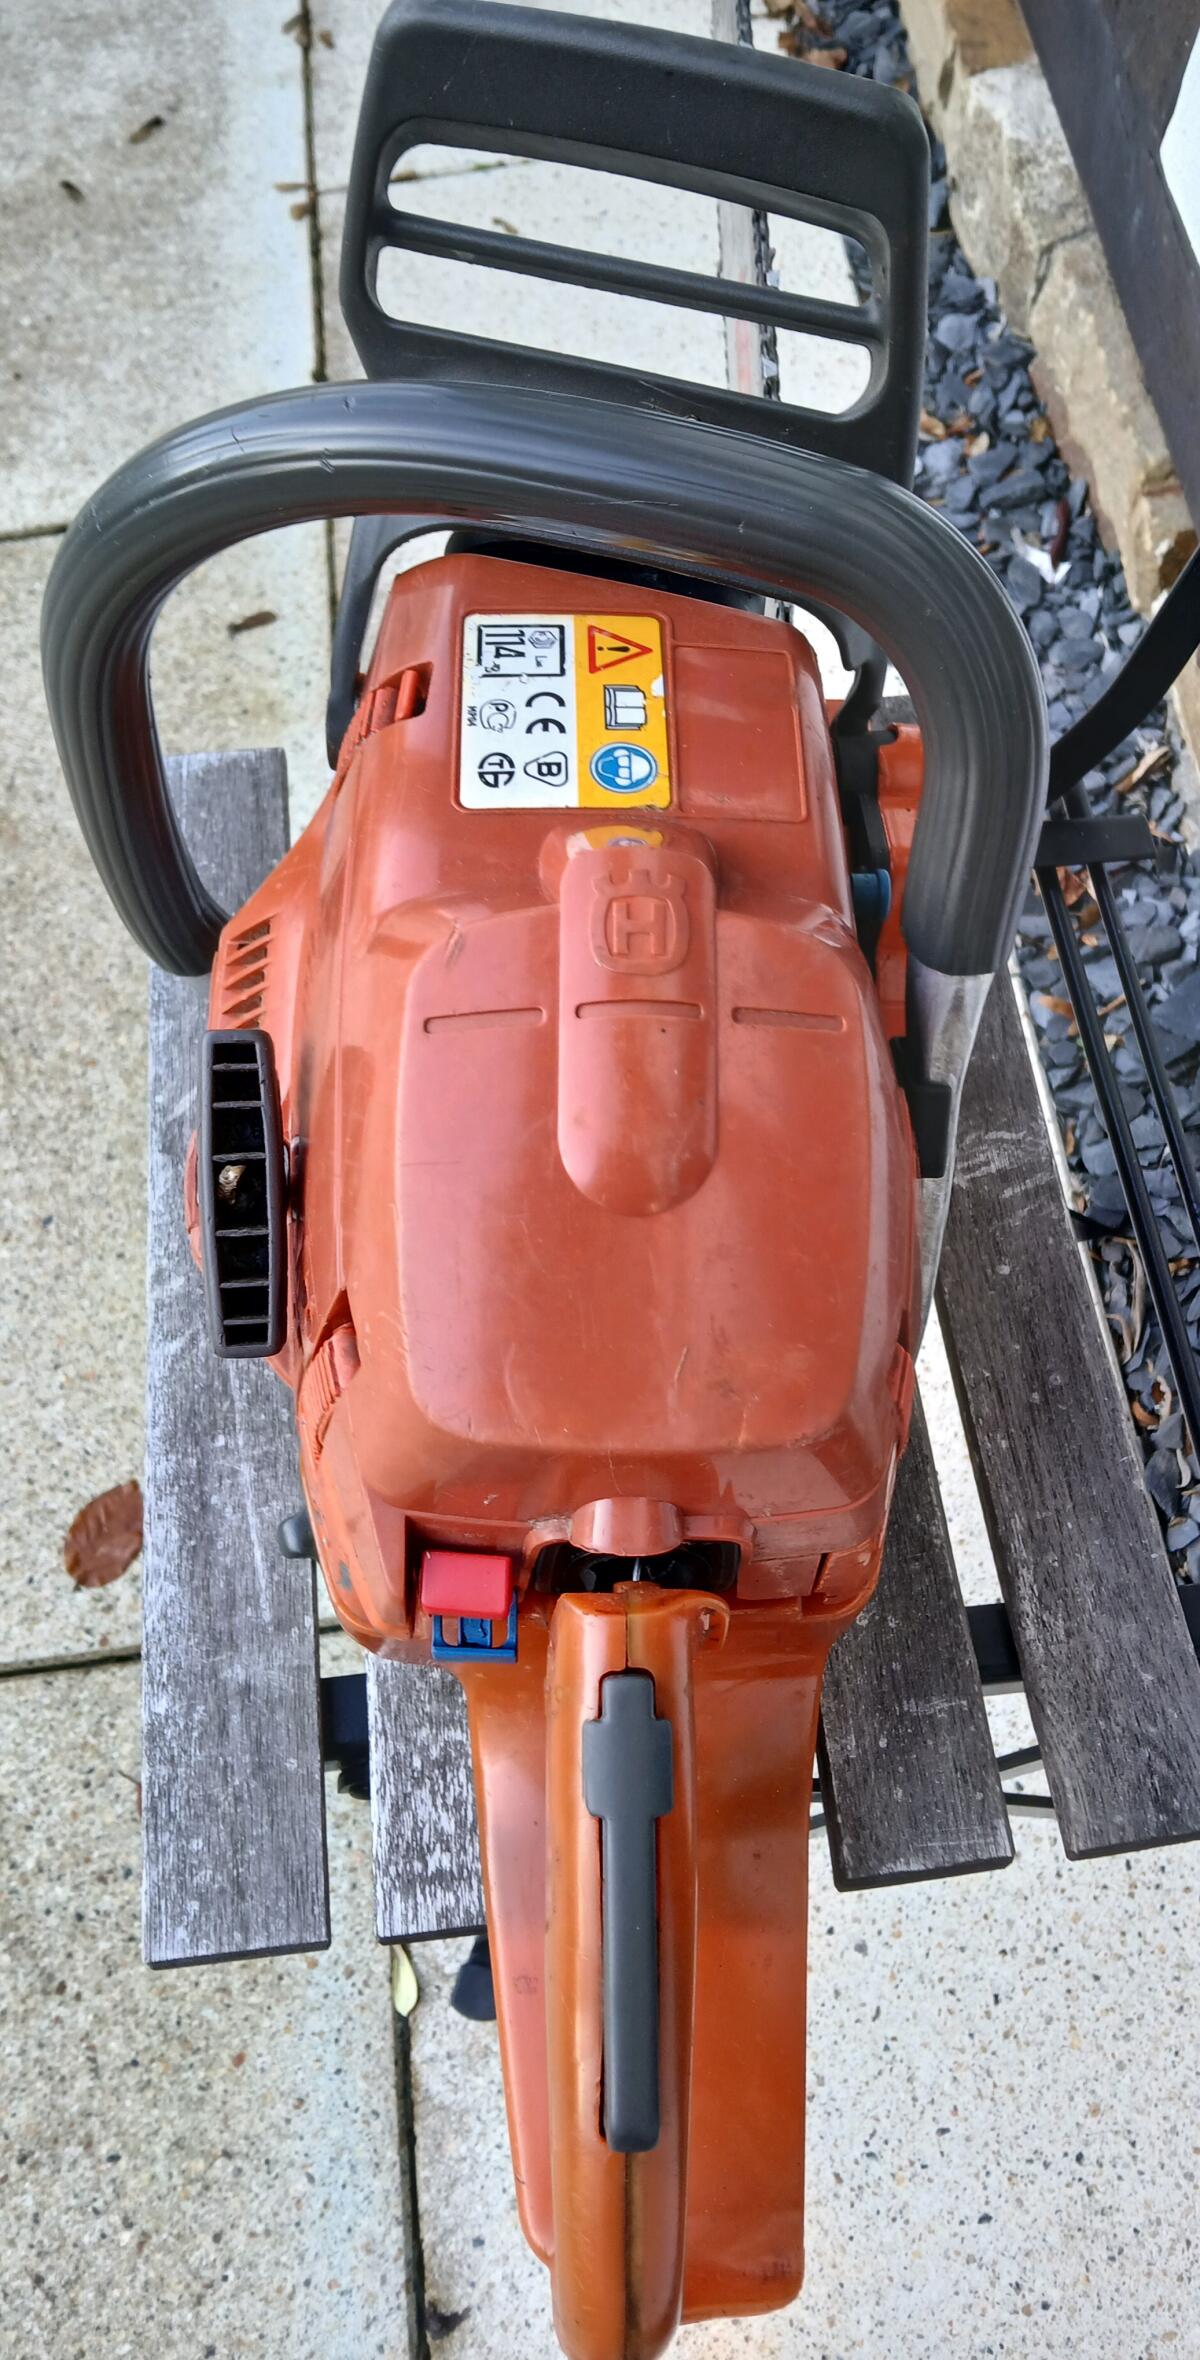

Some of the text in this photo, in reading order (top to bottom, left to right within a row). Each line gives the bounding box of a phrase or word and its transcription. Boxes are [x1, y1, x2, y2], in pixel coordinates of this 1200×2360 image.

[485, 629, 526, 659] 114
[525, 692, 566, 734] CE
[537, 762, 562, 777] B
